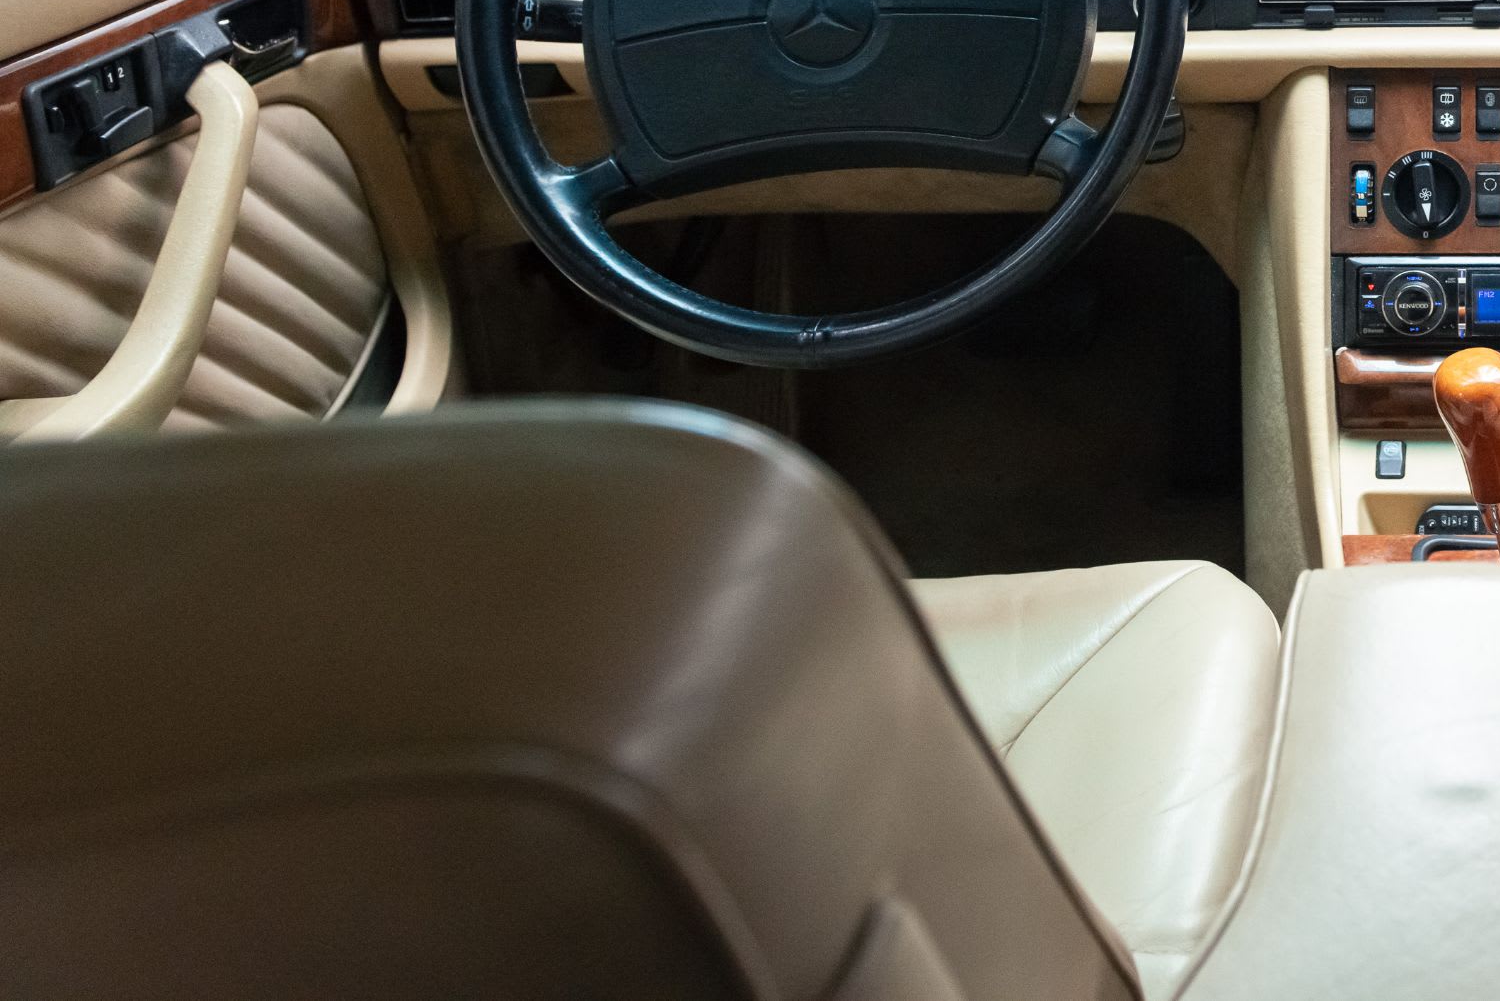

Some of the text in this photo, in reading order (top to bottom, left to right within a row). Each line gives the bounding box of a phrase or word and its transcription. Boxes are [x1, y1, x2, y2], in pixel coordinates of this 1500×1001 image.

[107, 66, 125, 83] 1 2
[1478, 290, 1495, 298] FM2
